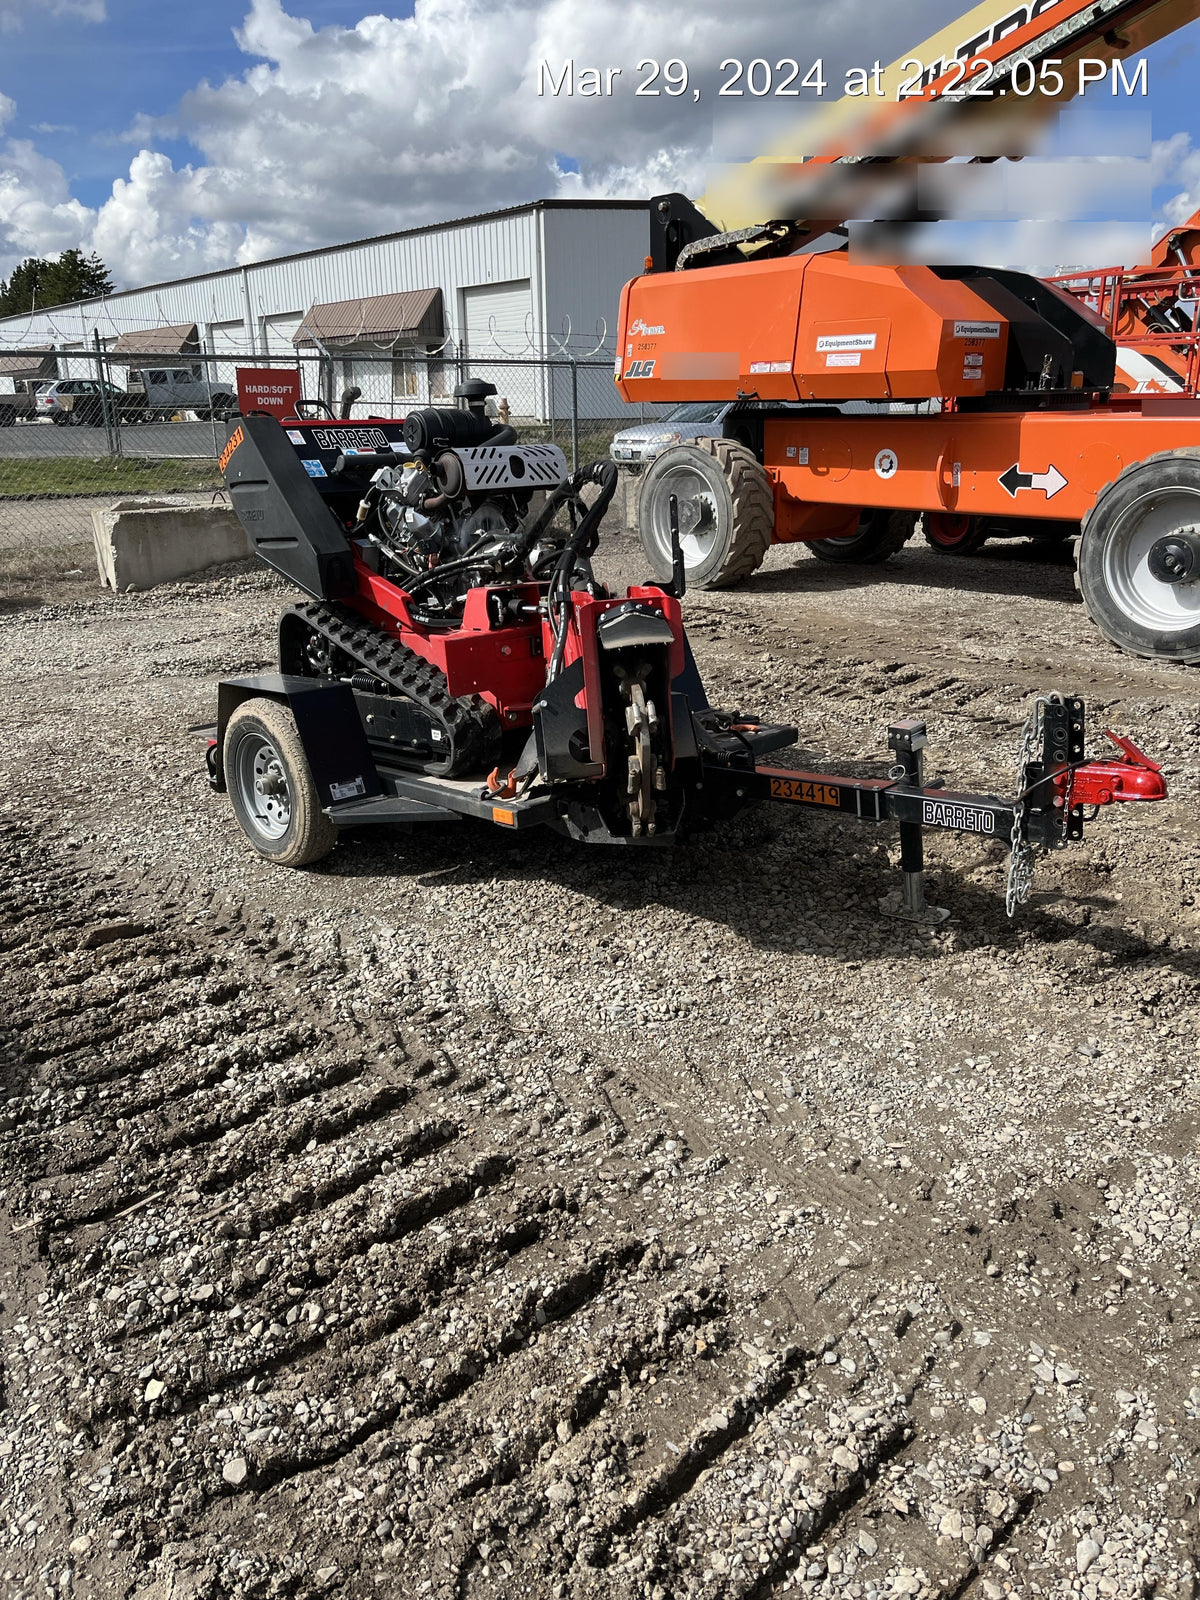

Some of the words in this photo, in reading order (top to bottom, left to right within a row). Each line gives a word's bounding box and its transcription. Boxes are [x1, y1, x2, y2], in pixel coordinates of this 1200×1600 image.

[824, 338, 873, 347] EquipmentShare
[625, 361, 655, 378] JLG
[245, 385, 293, 394] HARD/SOFT
[257, 396, 284, 405] DOWN
[312, 428, 389, 449] BARRETO
[771, 779, 840, 804] 234419
[923, 801, 994, 833] BARRETO
